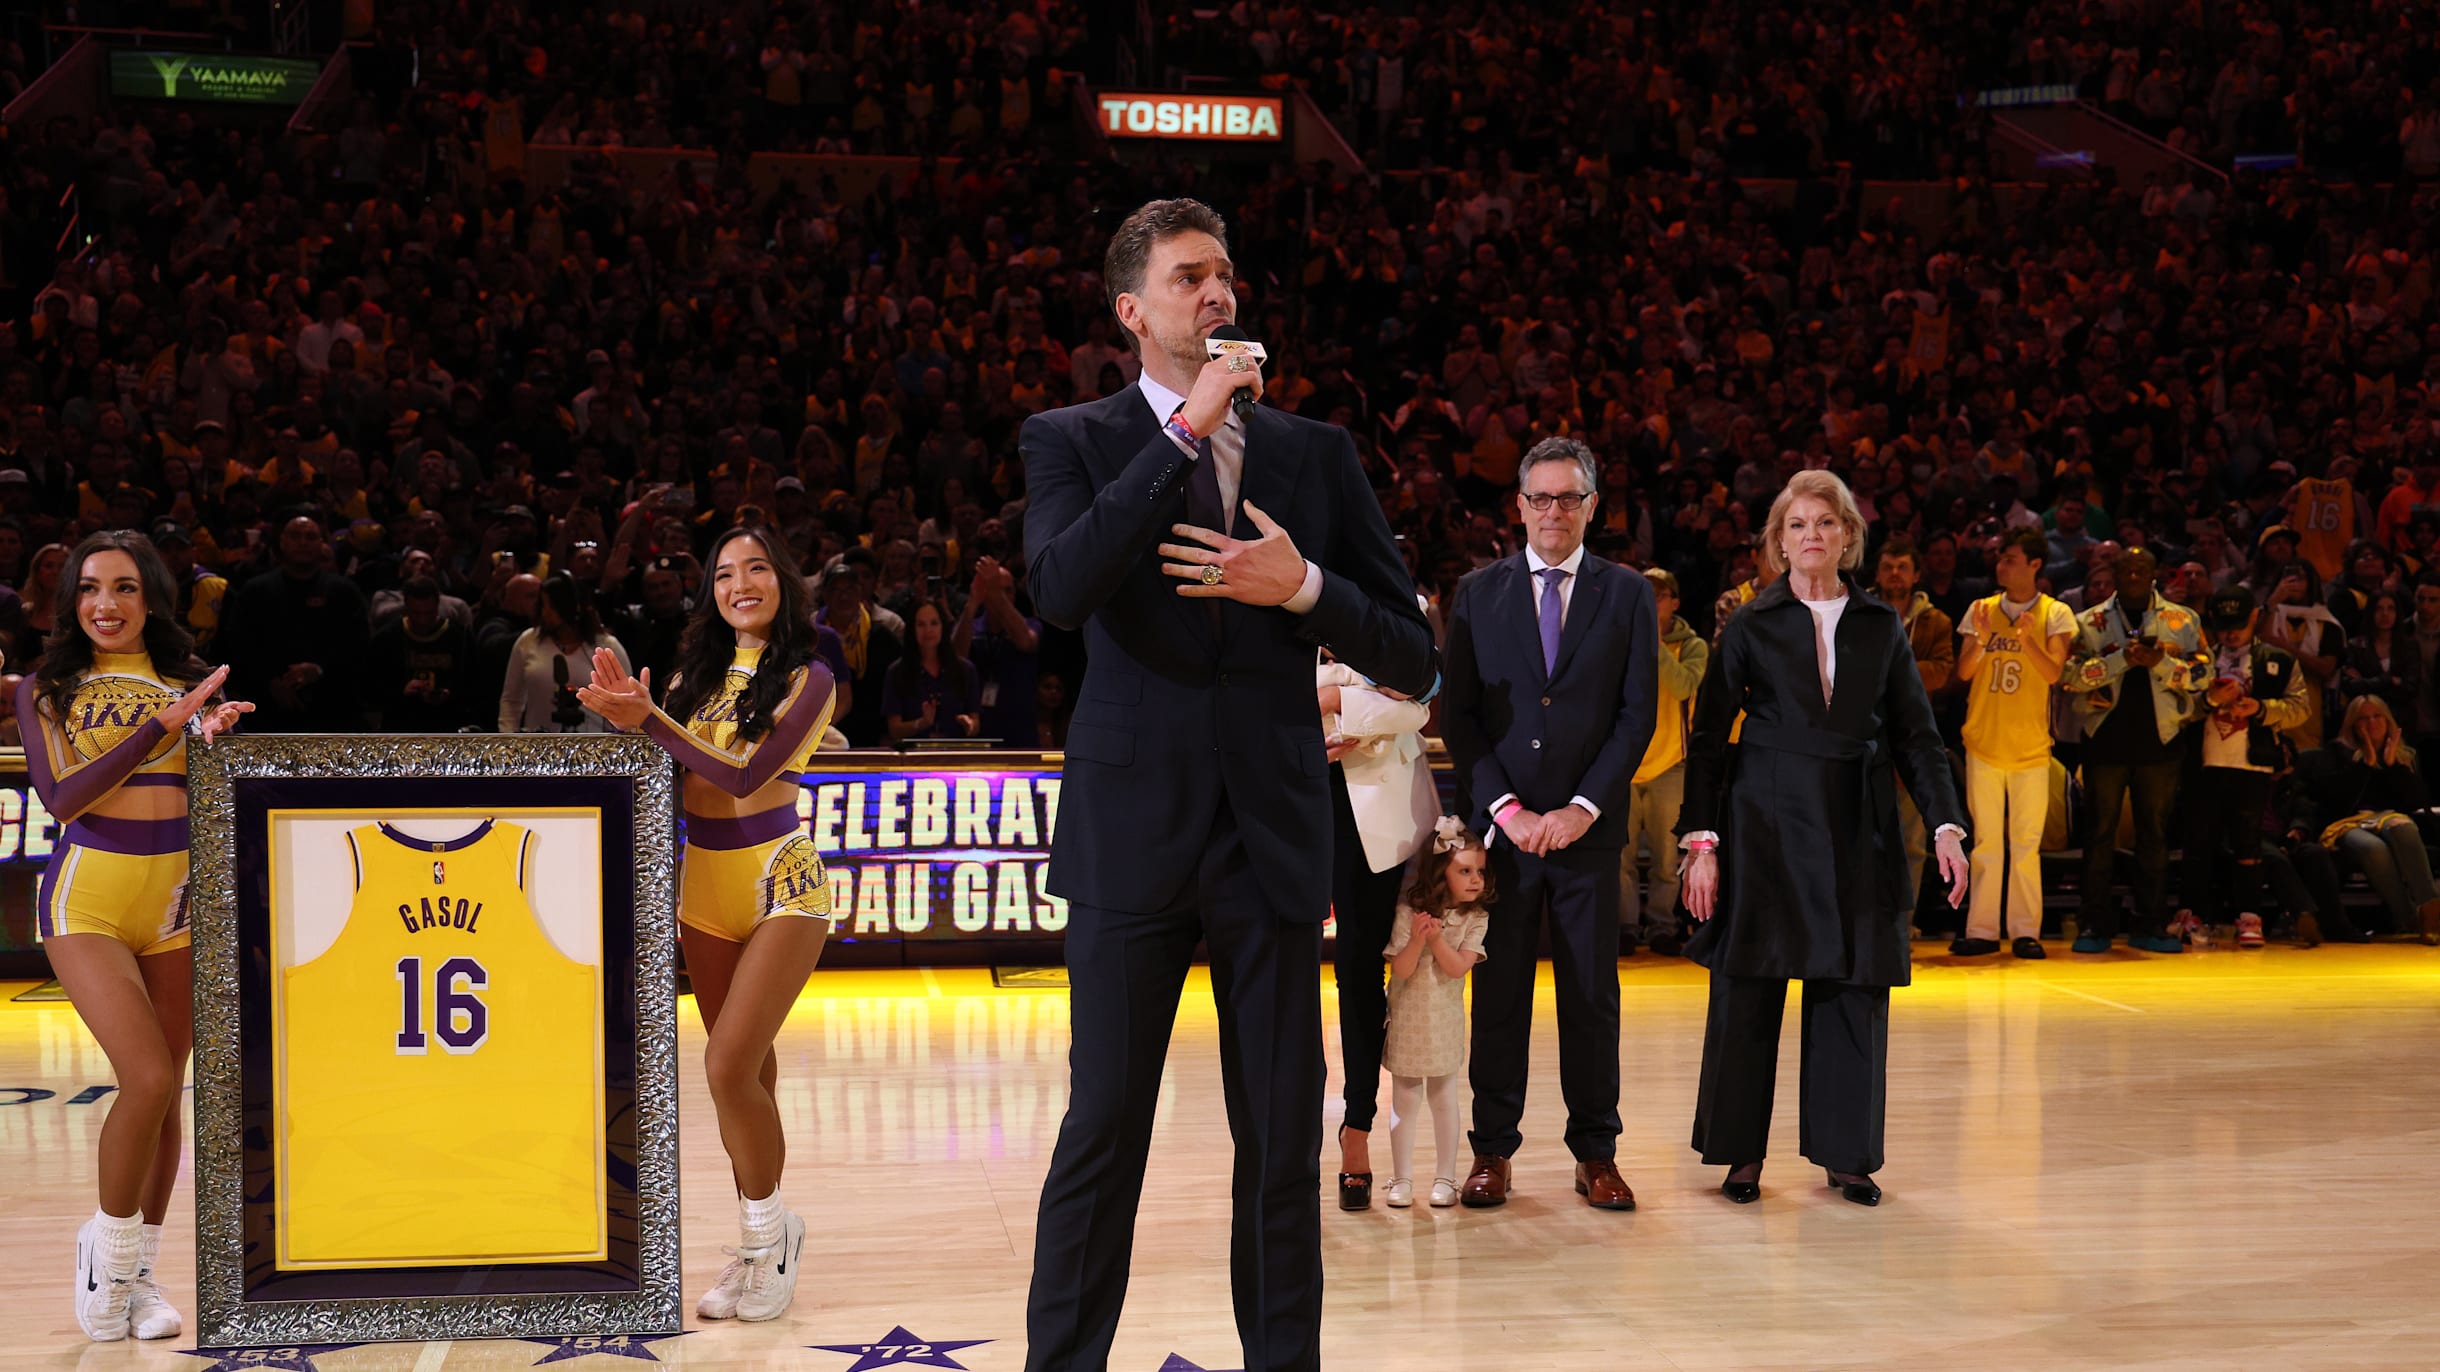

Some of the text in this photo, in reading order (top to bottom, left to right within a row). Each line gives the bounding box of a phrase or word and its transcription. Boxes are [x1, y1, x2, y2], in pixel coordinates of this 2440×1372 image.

[1102, 100, 1279, 137] TOSHIBA
[2307, 499, 2341, 531] 16
[1989, 657, 2022, 694] 16
[398, 896, 483, 934] GASOL
[827, 863, 931, 935] PAU
[395, 955, 489, 1056] 16
[226, 1348, 302, 1363] '53
[861, 1344, 934, 1359] '72
